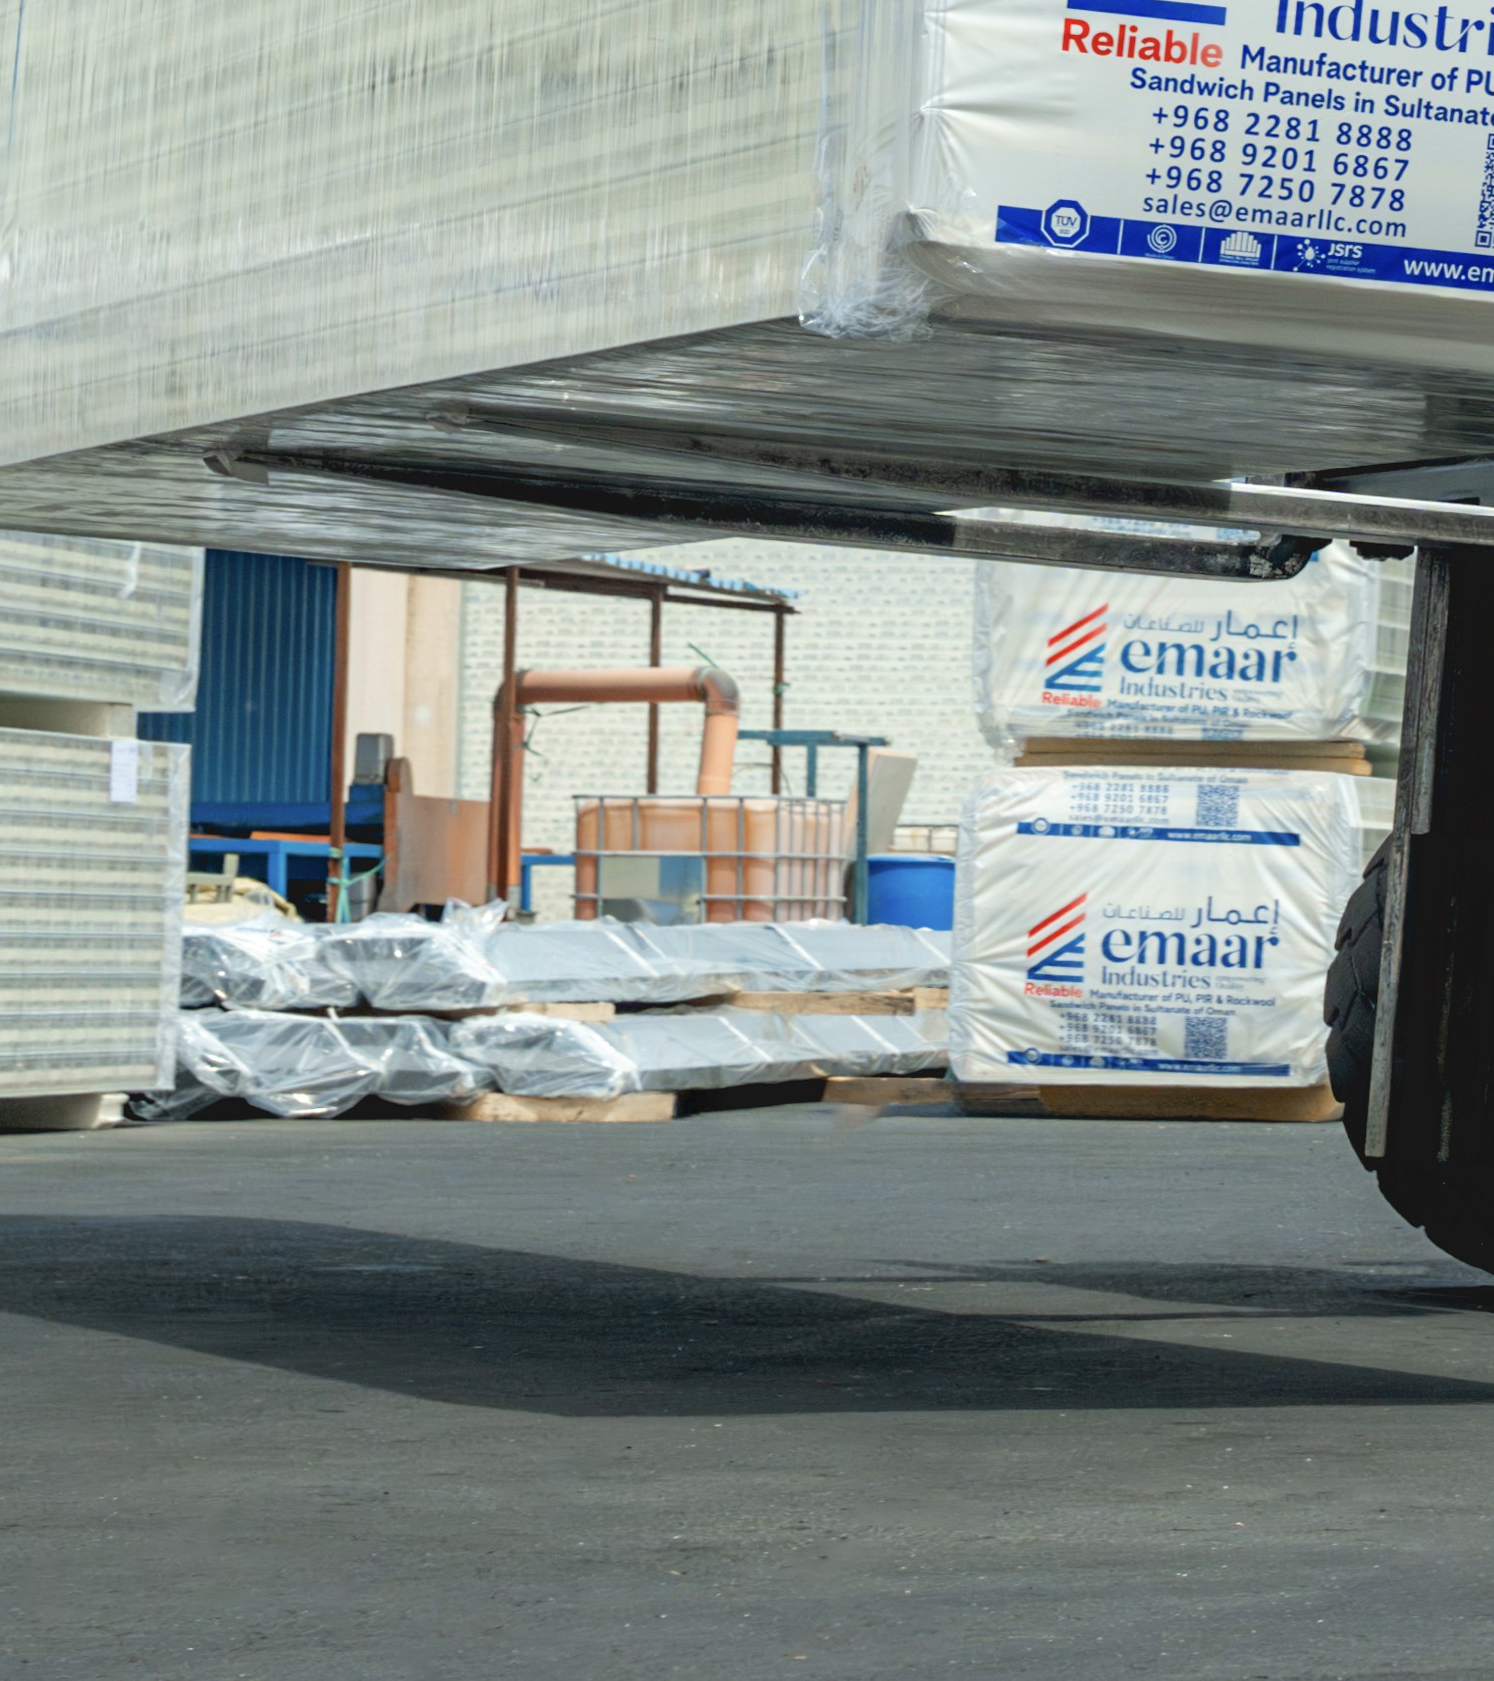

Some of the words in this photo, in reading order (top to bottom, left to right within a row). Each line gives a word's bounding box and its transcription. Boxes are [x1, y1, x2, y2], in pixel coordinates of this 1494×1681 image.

[1060, 17, 1223, 68] Reliable
[1240, 43, 1423, 88] Manufacturer
[1430, 66, 1459, 92] of
[1129, 66, 1254, 101] Sandwich
[1262, 80, 1345, 111] Panels
[1353, 90, 1375, 114] in
[1152, 104, 1229, 132] +968
[1244, 111, 1320, 142] 2281
[1335, 121, 1412, 152] 8888
[1148, 134, 1226, 163] +968
[1241, 142, 1316, 173] 9201
[1332, 151, 1409, 181] 6867
[1145, 165, 1223, 193] +968
[1238, 172, 1315, 203] 7250
[1330, 182, 1405, 212] 7878
[1142, 193, 1406, 238] sales@emaarllc.com
[1119, 639, 1297, 683] emaar
[1040, 691, 1101, 708] Reliable
[1119, 675, 1228, 702] Industries
[1099, 928, 1279, 969] emaar
[1022, 981, 1084, 998] Reliable
[1100, 965, 1210, 990] Industries
